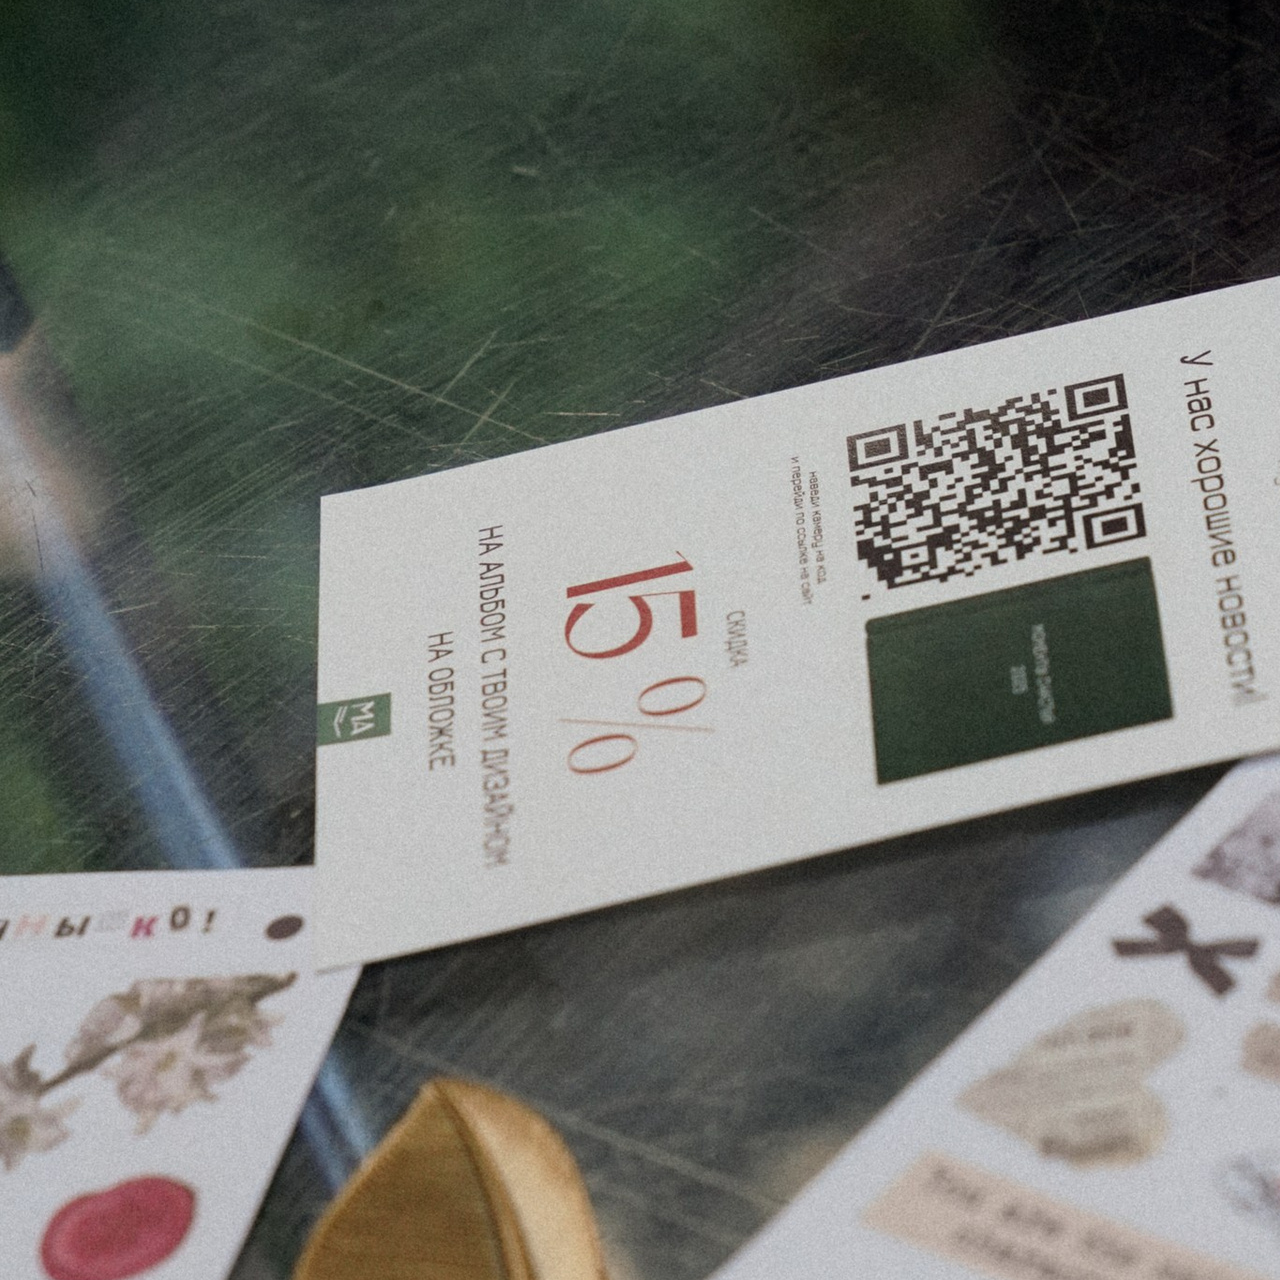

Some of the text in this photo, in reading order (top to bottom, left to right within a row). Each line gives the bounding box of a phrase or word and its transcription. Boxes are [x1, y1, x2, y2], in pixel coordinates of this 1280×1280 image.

[1184, 377, 1220, 432] нас
[791, 456, 814, 605] и перейди по ссылке на сайт
[809, 471, 827, 584] наведи камеру на код
[1191, 439, 1237, 568] хорошие
[428, 632, 456, 771] НА ОБЛОЖКЕ
[479, 525, 515, 869] НА АЛЬБОМ С ТВОИМ ДИЗАЙНОМ
[724, 610, 748, 668] СКИДКА
